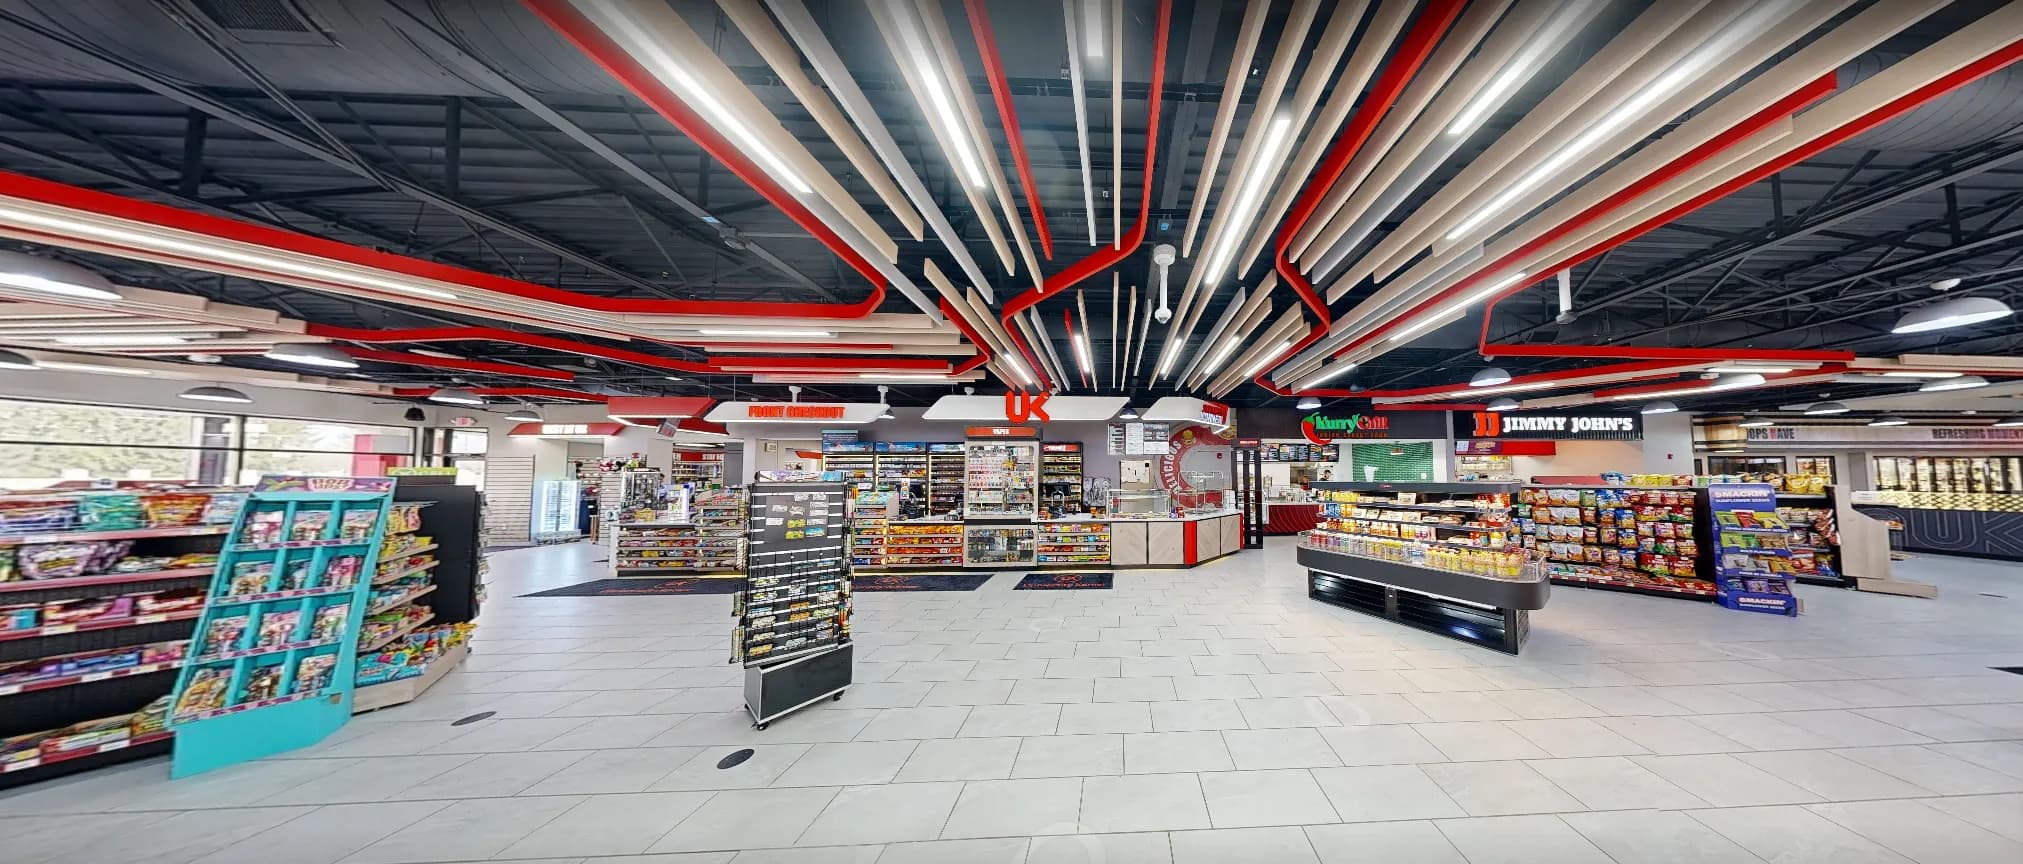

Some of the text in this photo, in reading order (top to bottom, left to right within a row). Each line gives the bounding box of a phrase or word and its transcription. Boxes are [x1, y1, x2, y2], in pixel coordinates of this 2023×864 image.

[1005, 390, 1050, 424] UK
[1503, 417, 1633, 433] JIMMY JOHN'S
[1746, 428, 1768, 440] OPS
